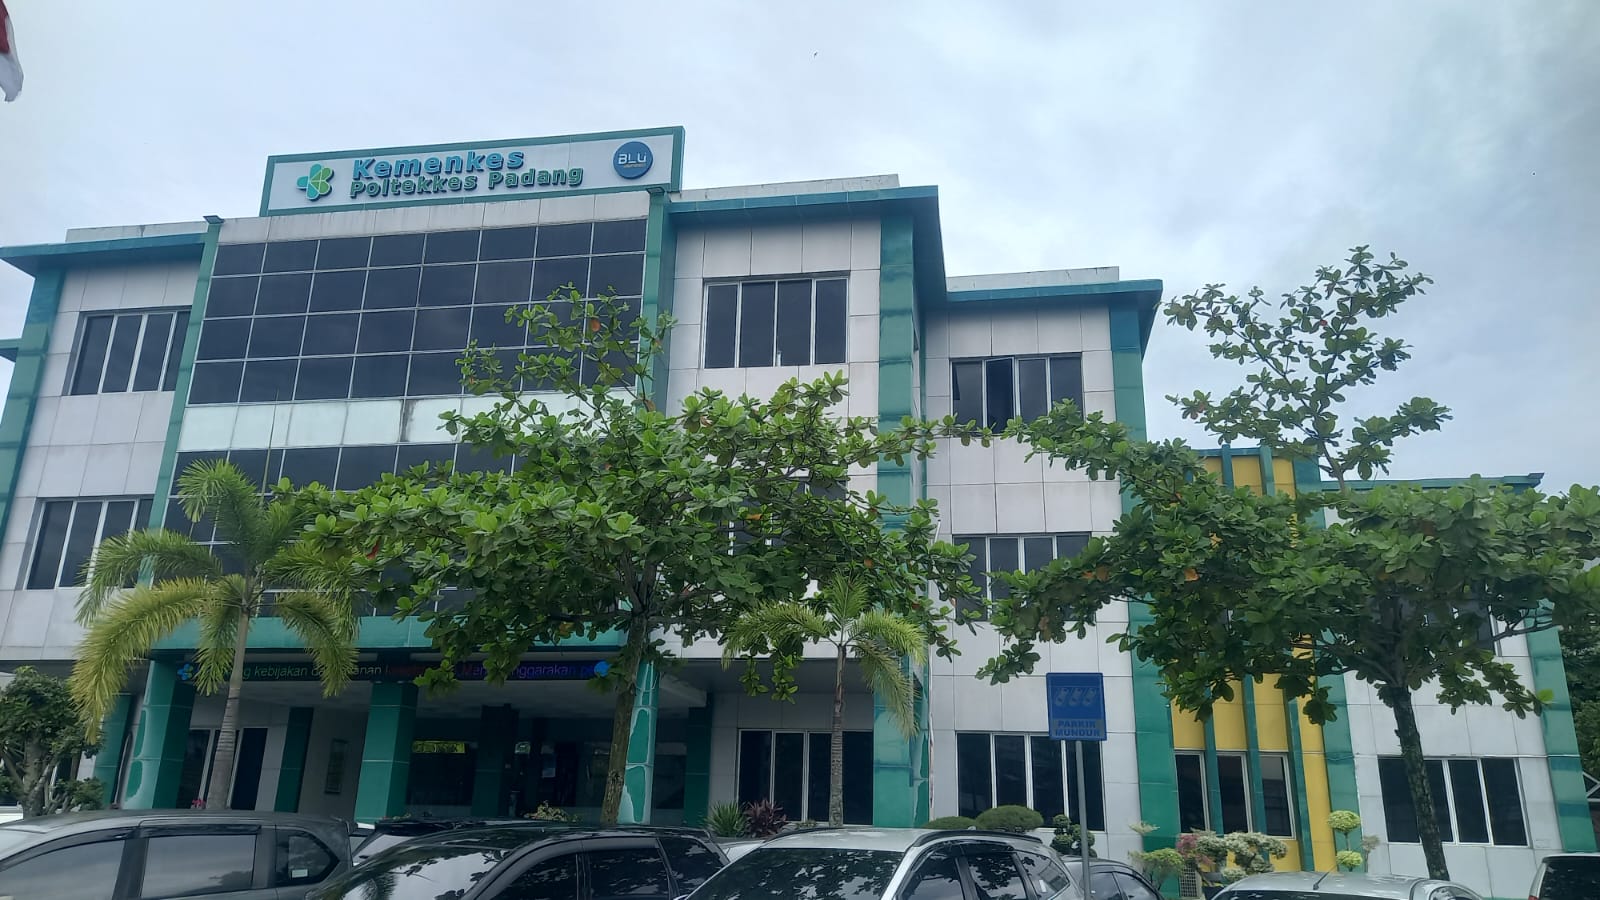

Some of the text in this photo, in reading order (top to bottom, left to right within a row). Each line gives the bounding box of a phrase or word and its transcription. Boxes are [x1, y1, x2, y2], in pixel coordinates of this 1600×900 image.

[352, 151, 525, 180] Kemenkes
[350, 167, 584, 199] Poltekkes Padang
[254, 666, 308, 680] kebijakan
[1057, 720, 1096, 728] PARKIR
[1055, 729, 1100, 737] MUNDUR
